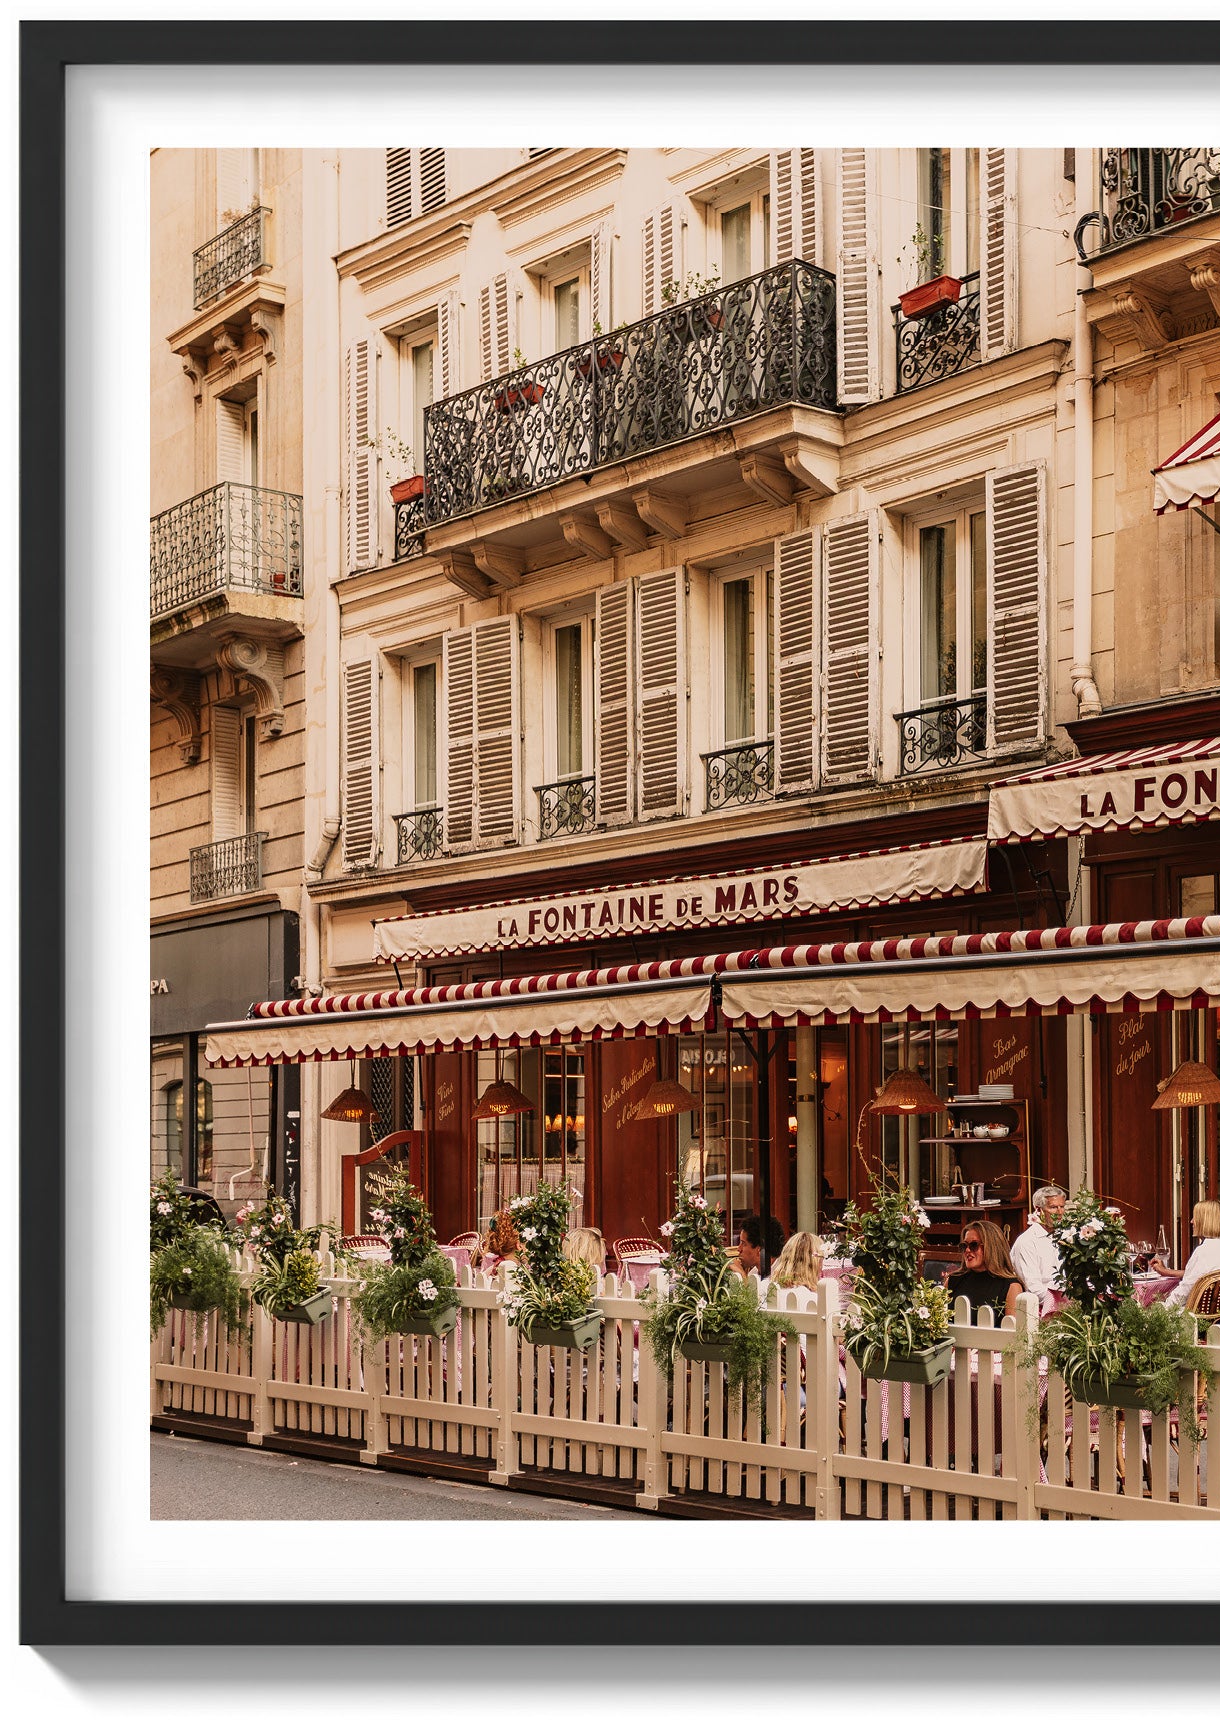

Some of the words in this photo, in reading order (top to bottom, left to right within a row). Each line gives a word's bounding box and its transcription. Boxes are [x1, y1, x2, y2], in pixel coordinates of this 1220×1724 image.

[1080, 791, 1117, 819] LA
[497, 919, 519, 938] LA
[528, 893, 665, 936] FONTAINE
[677, 896, 702, 918] DE
[715, 875, 799, 914] MARS
[1119, 1012, 1146, 1045] Plat
[993, 1034, 1017, 1059] Bas
[1116, 1054, 1128, 1076] du
[1129, 1040, 1152, 1076] jour
[602, 1087, 621, 1113] Salon
